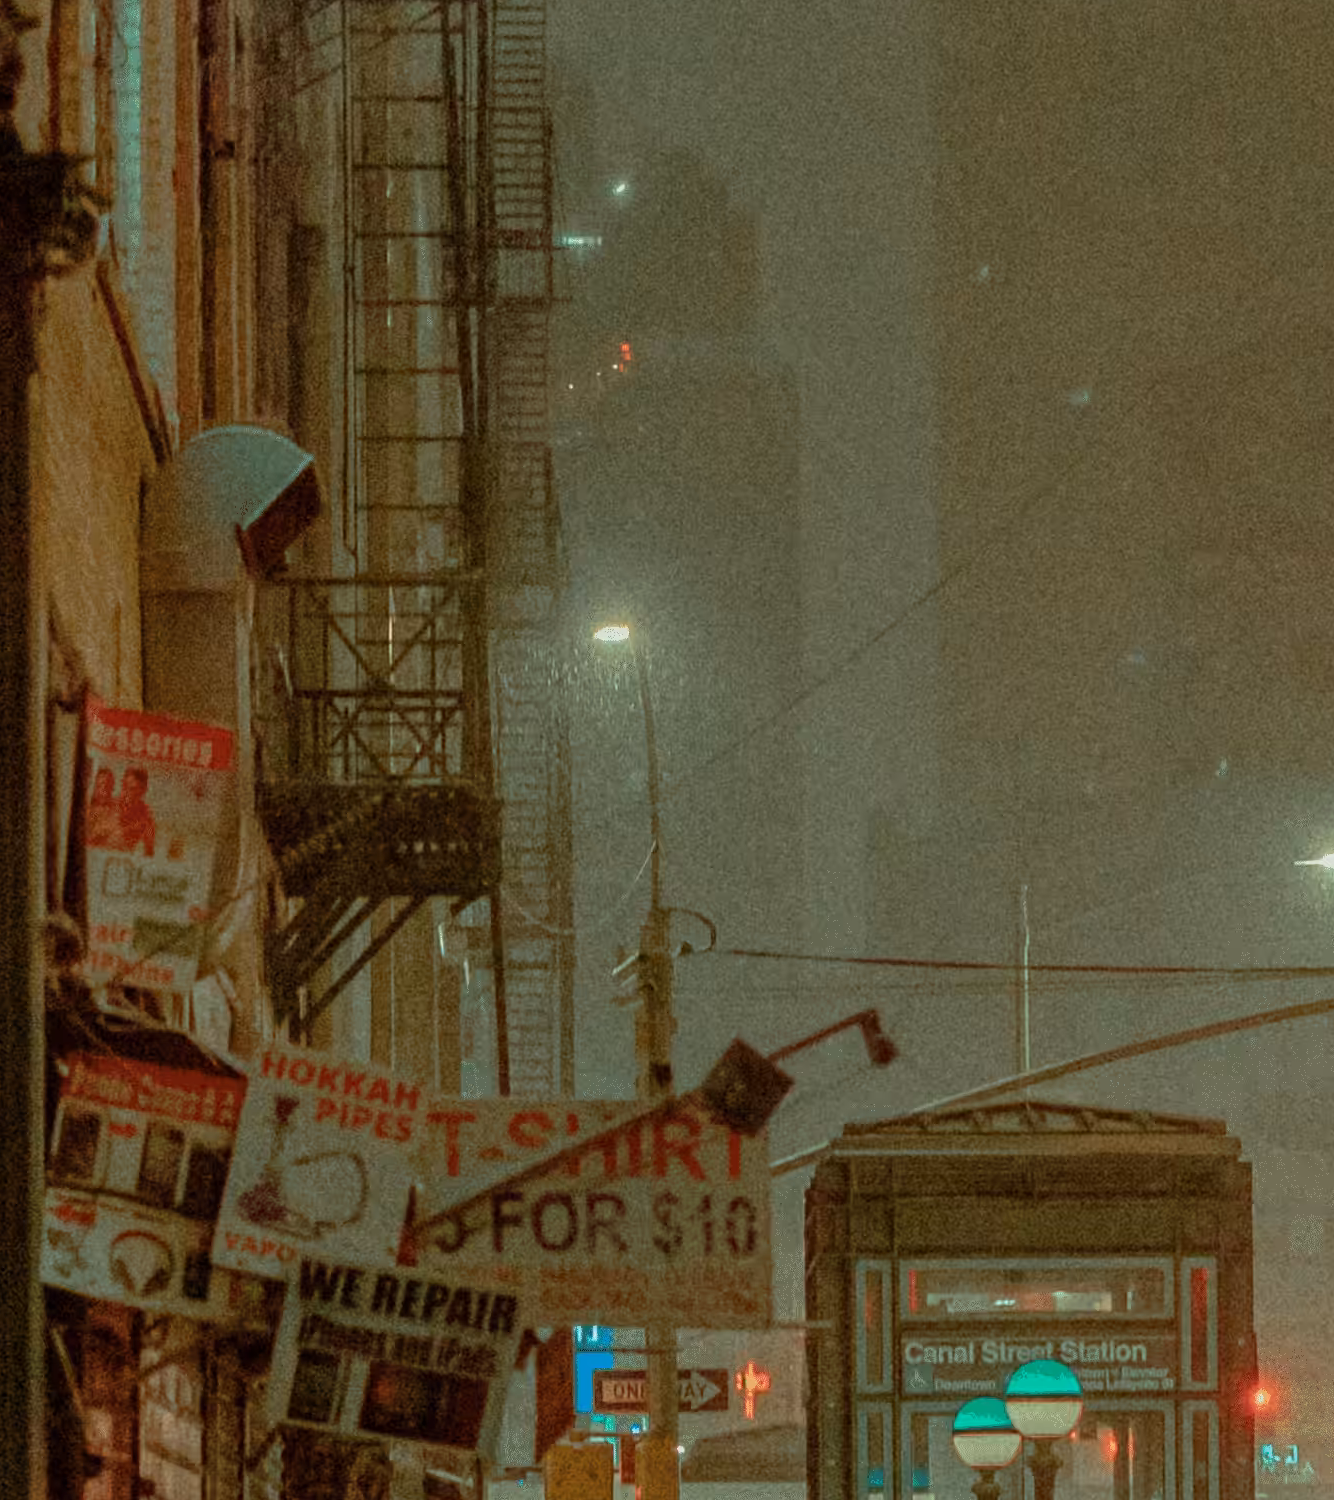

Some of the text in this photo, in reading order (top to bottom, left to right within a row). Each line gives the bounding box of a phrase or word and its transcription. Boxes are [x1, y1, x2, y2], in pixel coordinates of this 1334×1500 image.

[261, 1051, 421, 1112] HOKKAH
[315, 1098, 413, 1143] PIPES
[491, 1190, 627, 1254] FOR
[652, 1190, 759, 1257] $10
[299, 1259, 362, 1309] WE
[370, 1273, 518, 1334] REPAIR
[904, 1339, 1148, 1364] Canal Street Station
[678, 1381, 707, 1399] AY
